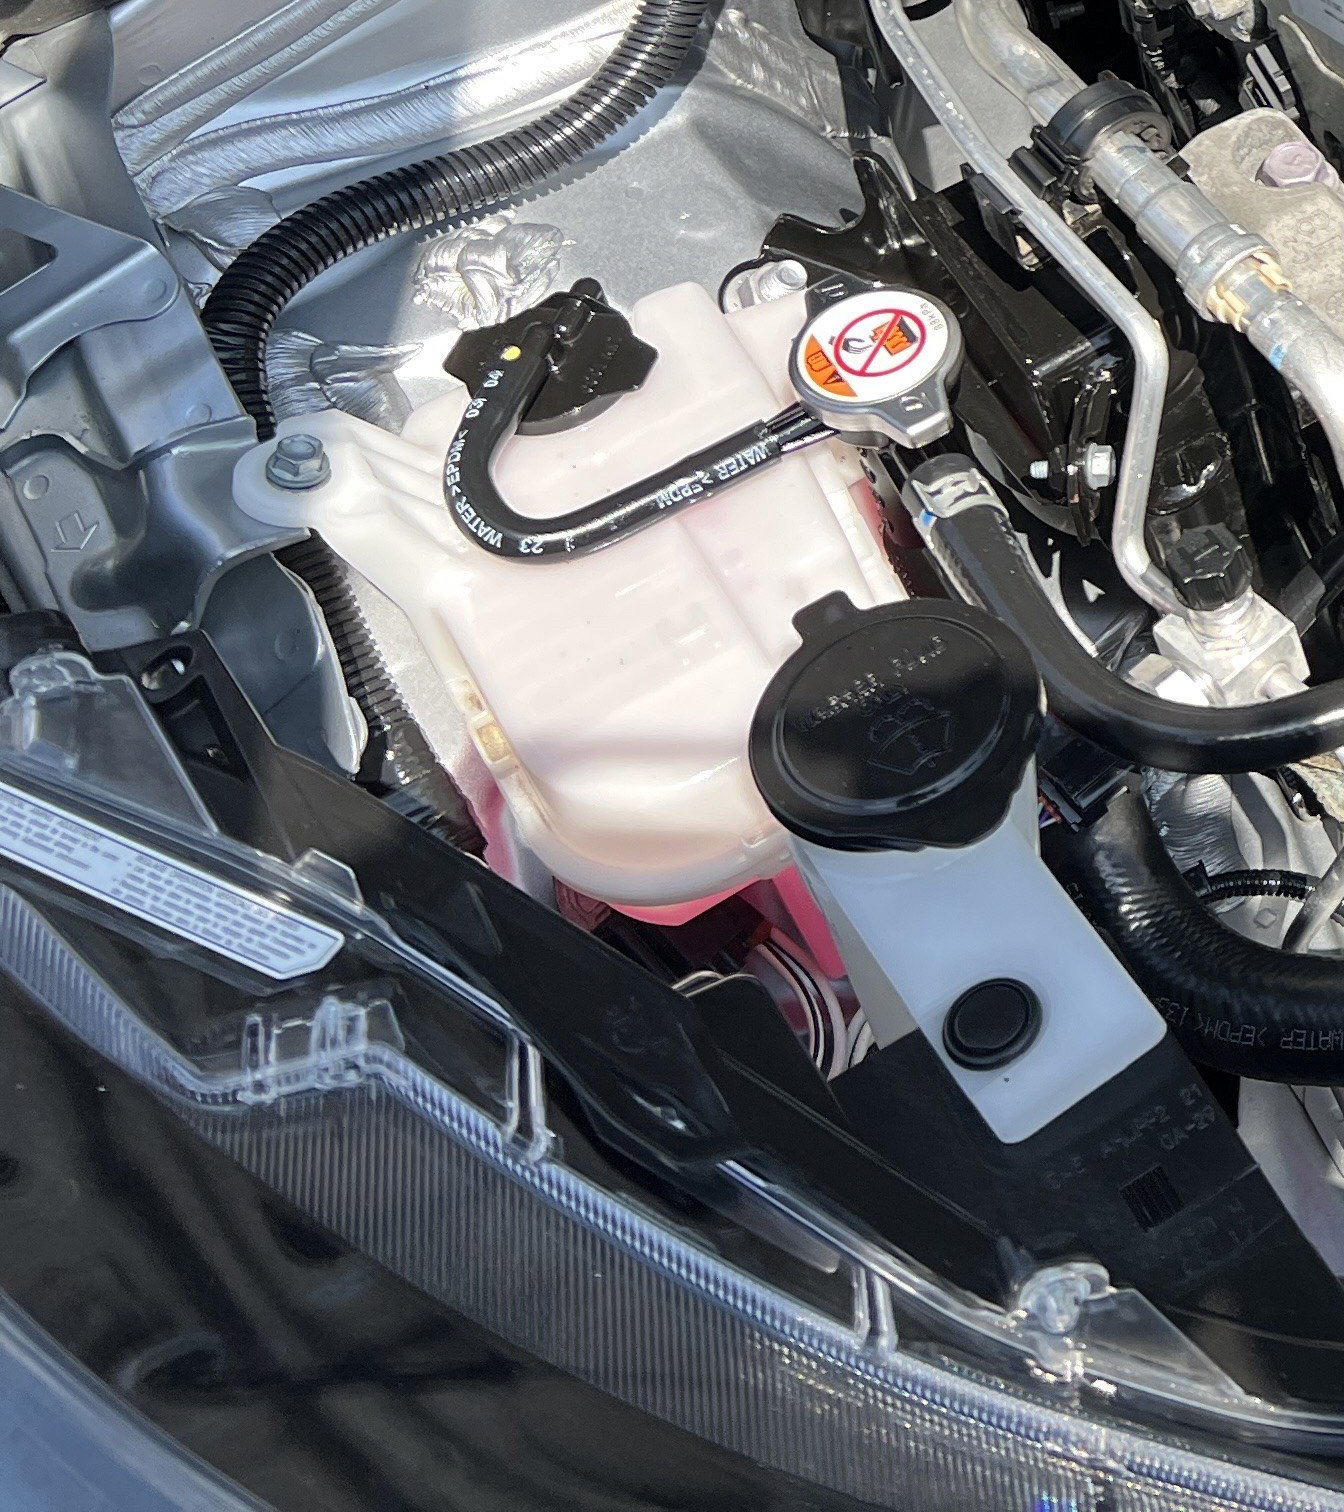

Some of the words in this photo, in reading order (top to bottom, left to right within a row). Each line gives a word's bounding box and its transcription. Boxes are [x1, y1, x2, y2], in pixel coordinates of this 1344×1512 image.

[714, 443, 778, 481] WATER
[455, 496, 506, 549] WATER
[519, 538, 543, 555] 23
[1280, 1027, 1342, 1048] WATER
